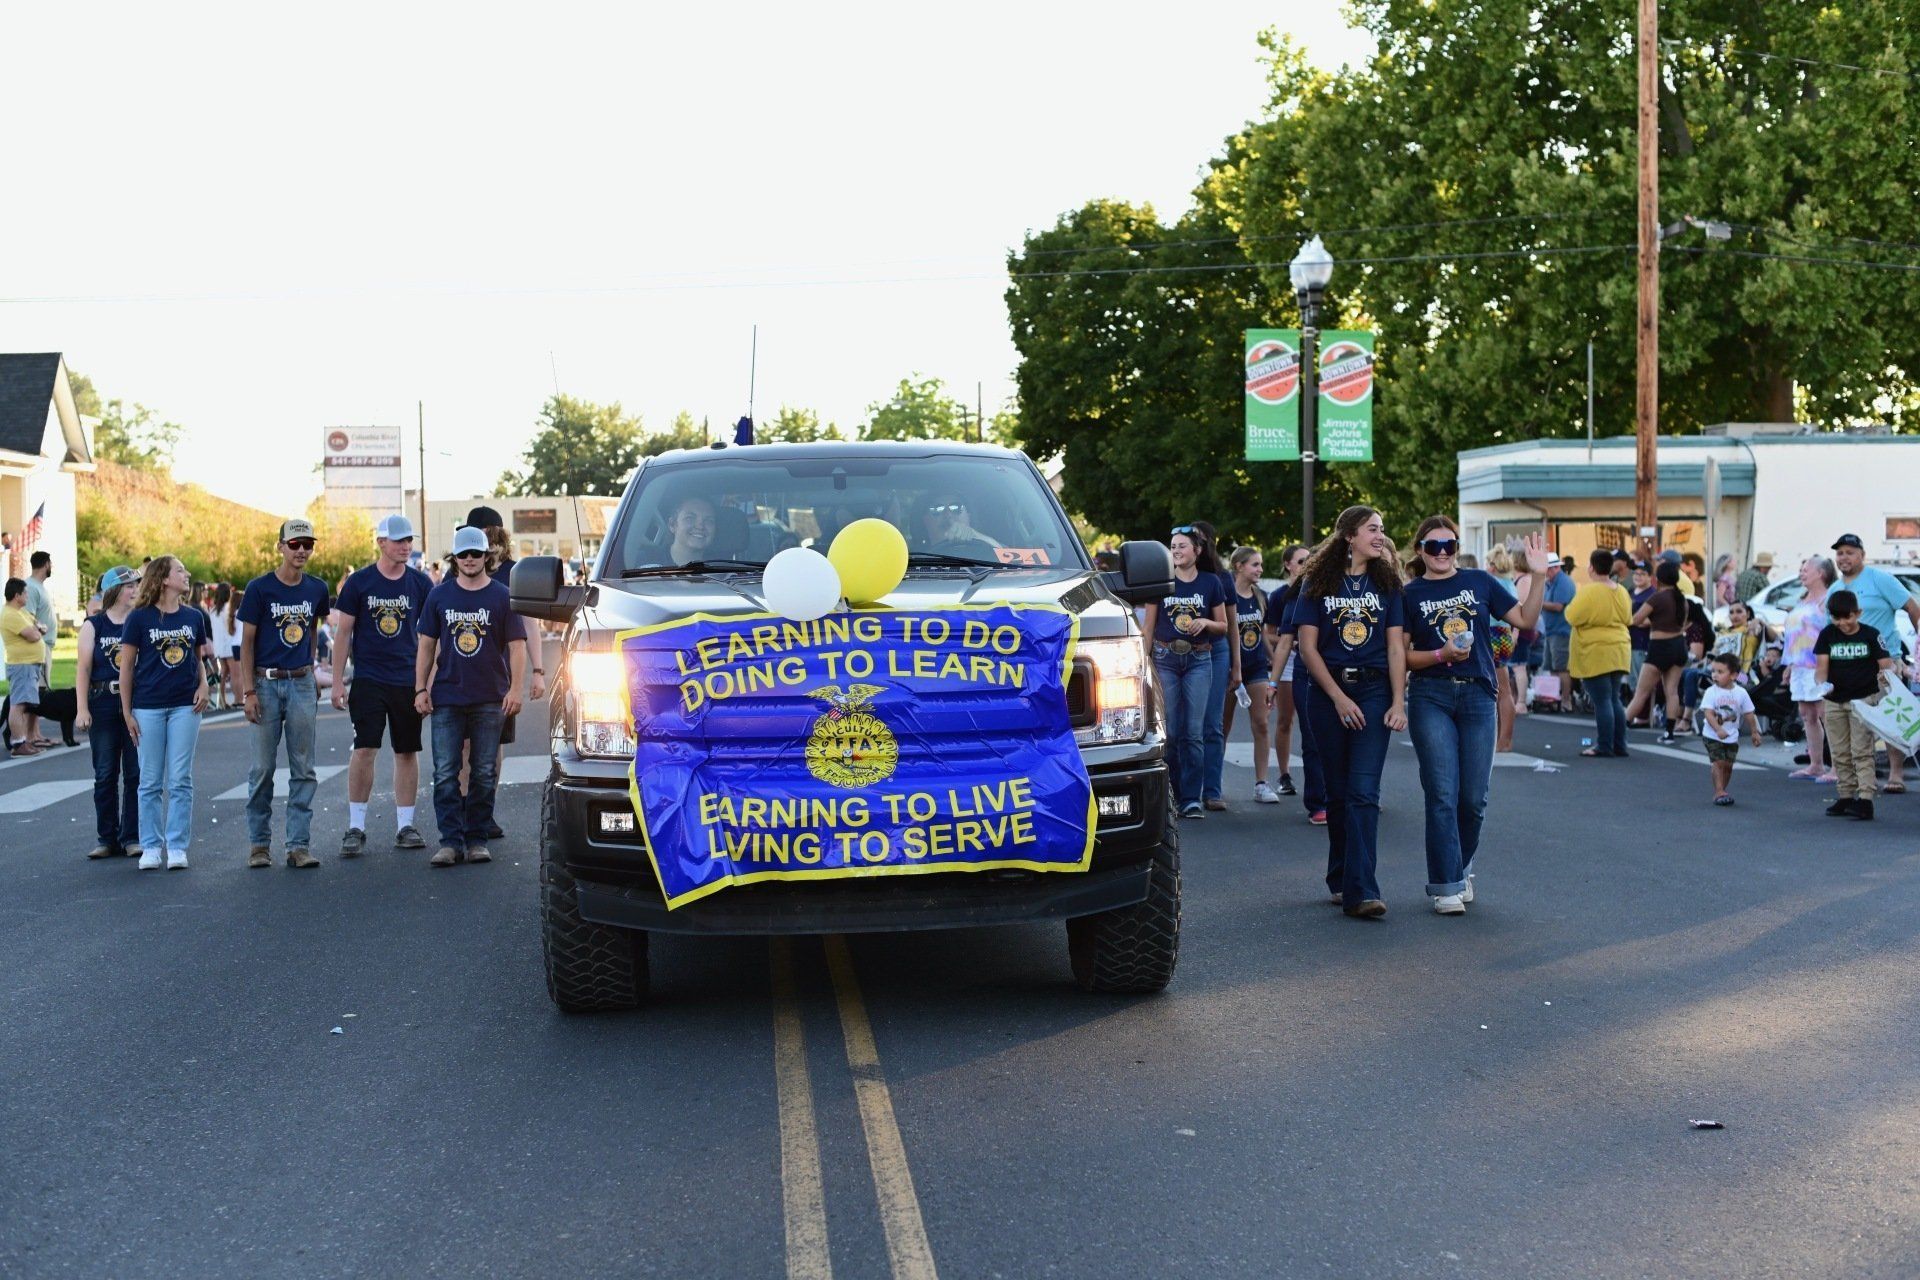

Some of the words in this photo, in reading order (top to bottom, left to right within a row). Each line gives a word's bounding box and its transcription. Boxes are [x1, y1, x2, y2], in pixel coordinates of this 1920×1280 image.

[1248, 424, 1286, 438] Bruce
[1323, 419, 1368, 429] Jimmy's
[1328, 429, 1362, 438] Johns
[1322, 438, 1369, 448] Portable
[1329, 448, 1363, 457] Toilets
[271, 600, 313, 618] HERMISTON
[368, 594, 412, 610] HERMISTON
[1163, 593, 1205, 608] HERMISTON
[1323, 592, 1383, 615] HERMISTON
[1420, 590, 1480, 618] HERMISTON
[445, 608, 491, 626] HERMISTON
[149, 625, 195, 643] HERMISTON
[676, 617, 882, 676] LEARNING
[895, 617, 950, 645] TO
[963, 620, 1021, 655] DO
[1831, 645, 1868, 656] MEXICO
[680, 657, 807, 712] DOING
[817, 650, 874, 680] TO
[889, 650, 1024, 688] LEARN
[820, 725, 884, 756] AGRICULTURAL
[835, 738, 872, 750] FFA
[700, 793, 870, 828] EARNING
[882, 792, 937, 824] TO
[949, 777, 1036, 818] LIVE
[834, 830, 890, 864] TO
[903, 812, 1036, 859] SERVE
